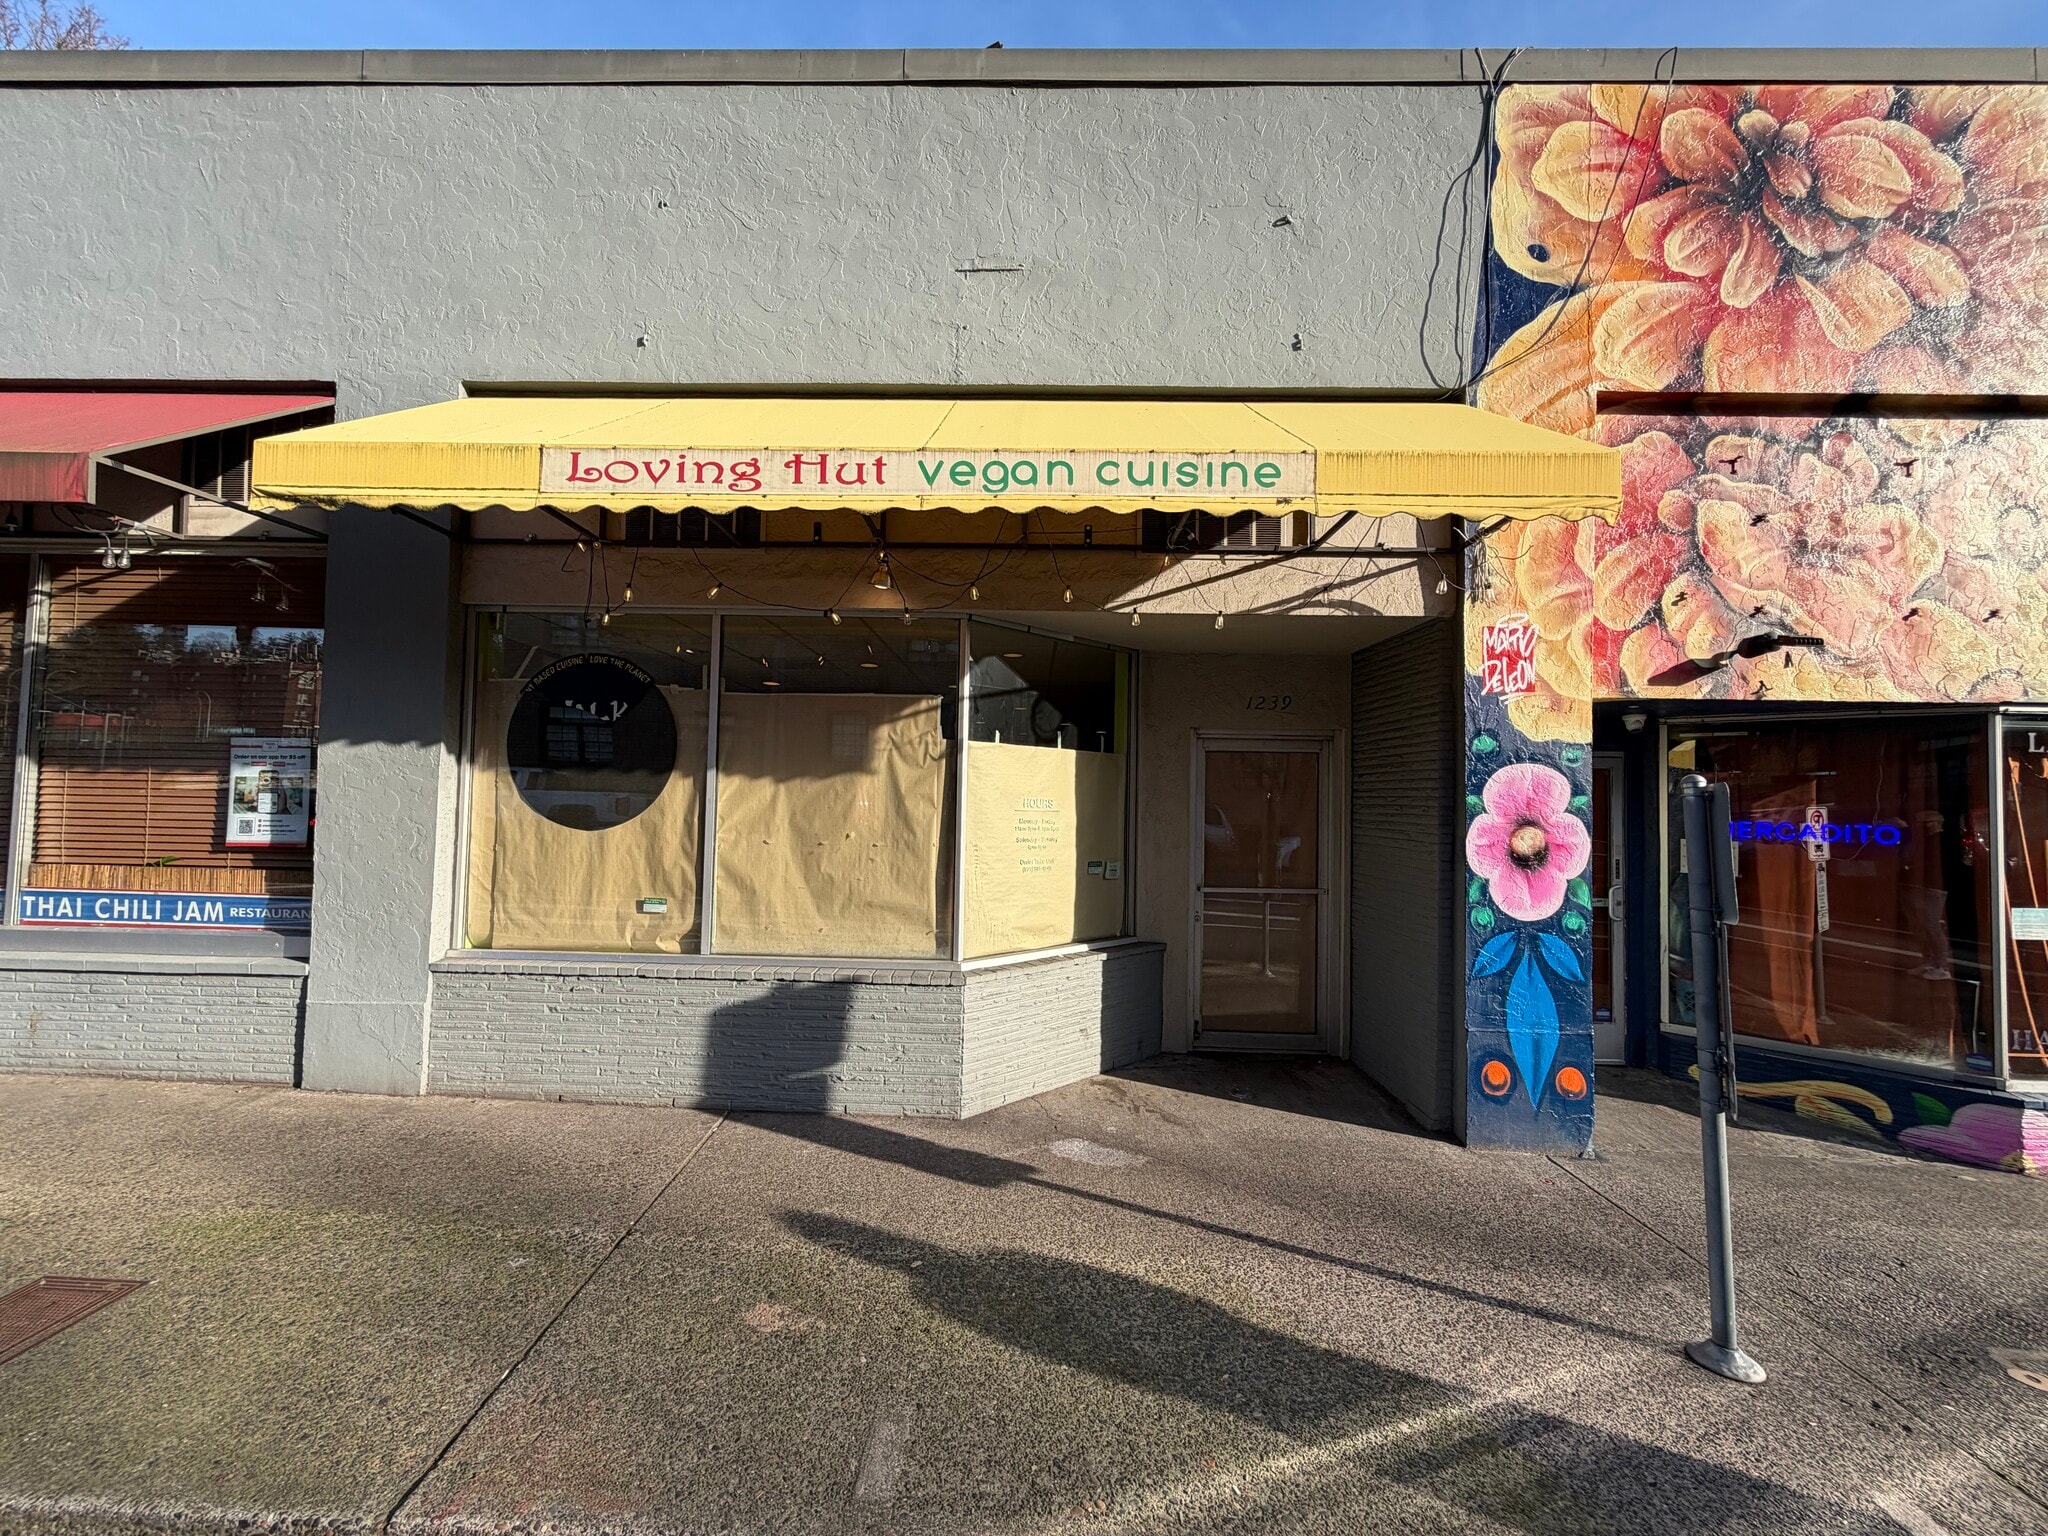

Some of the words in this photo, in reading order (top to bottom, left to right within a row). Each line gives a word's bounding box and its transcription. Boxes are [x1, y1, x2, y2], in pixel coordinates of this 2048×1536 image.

[565, 451, 762, 493] Loving
[784, 453, 888, 486] Hut
[917, 459, 1074, 494] vegan
[1095, 460, 1282, 489] cuisine
[534, 667, 555, 686] BASED
[556, 656, 584, 671] CUISINE
[589, 655, 609, 665] LOVE
[610, 658, 625, 669] THE
[625, 663, 651, 684] PLANET
[1246, 696, 1292, 710] 1239
[1023, 798, 1054, 809] HOURS
[22, 895, 82, 918] THAI
[95, 898, 161, 920] CHILI
[172, 901, 224, 922] JAM
